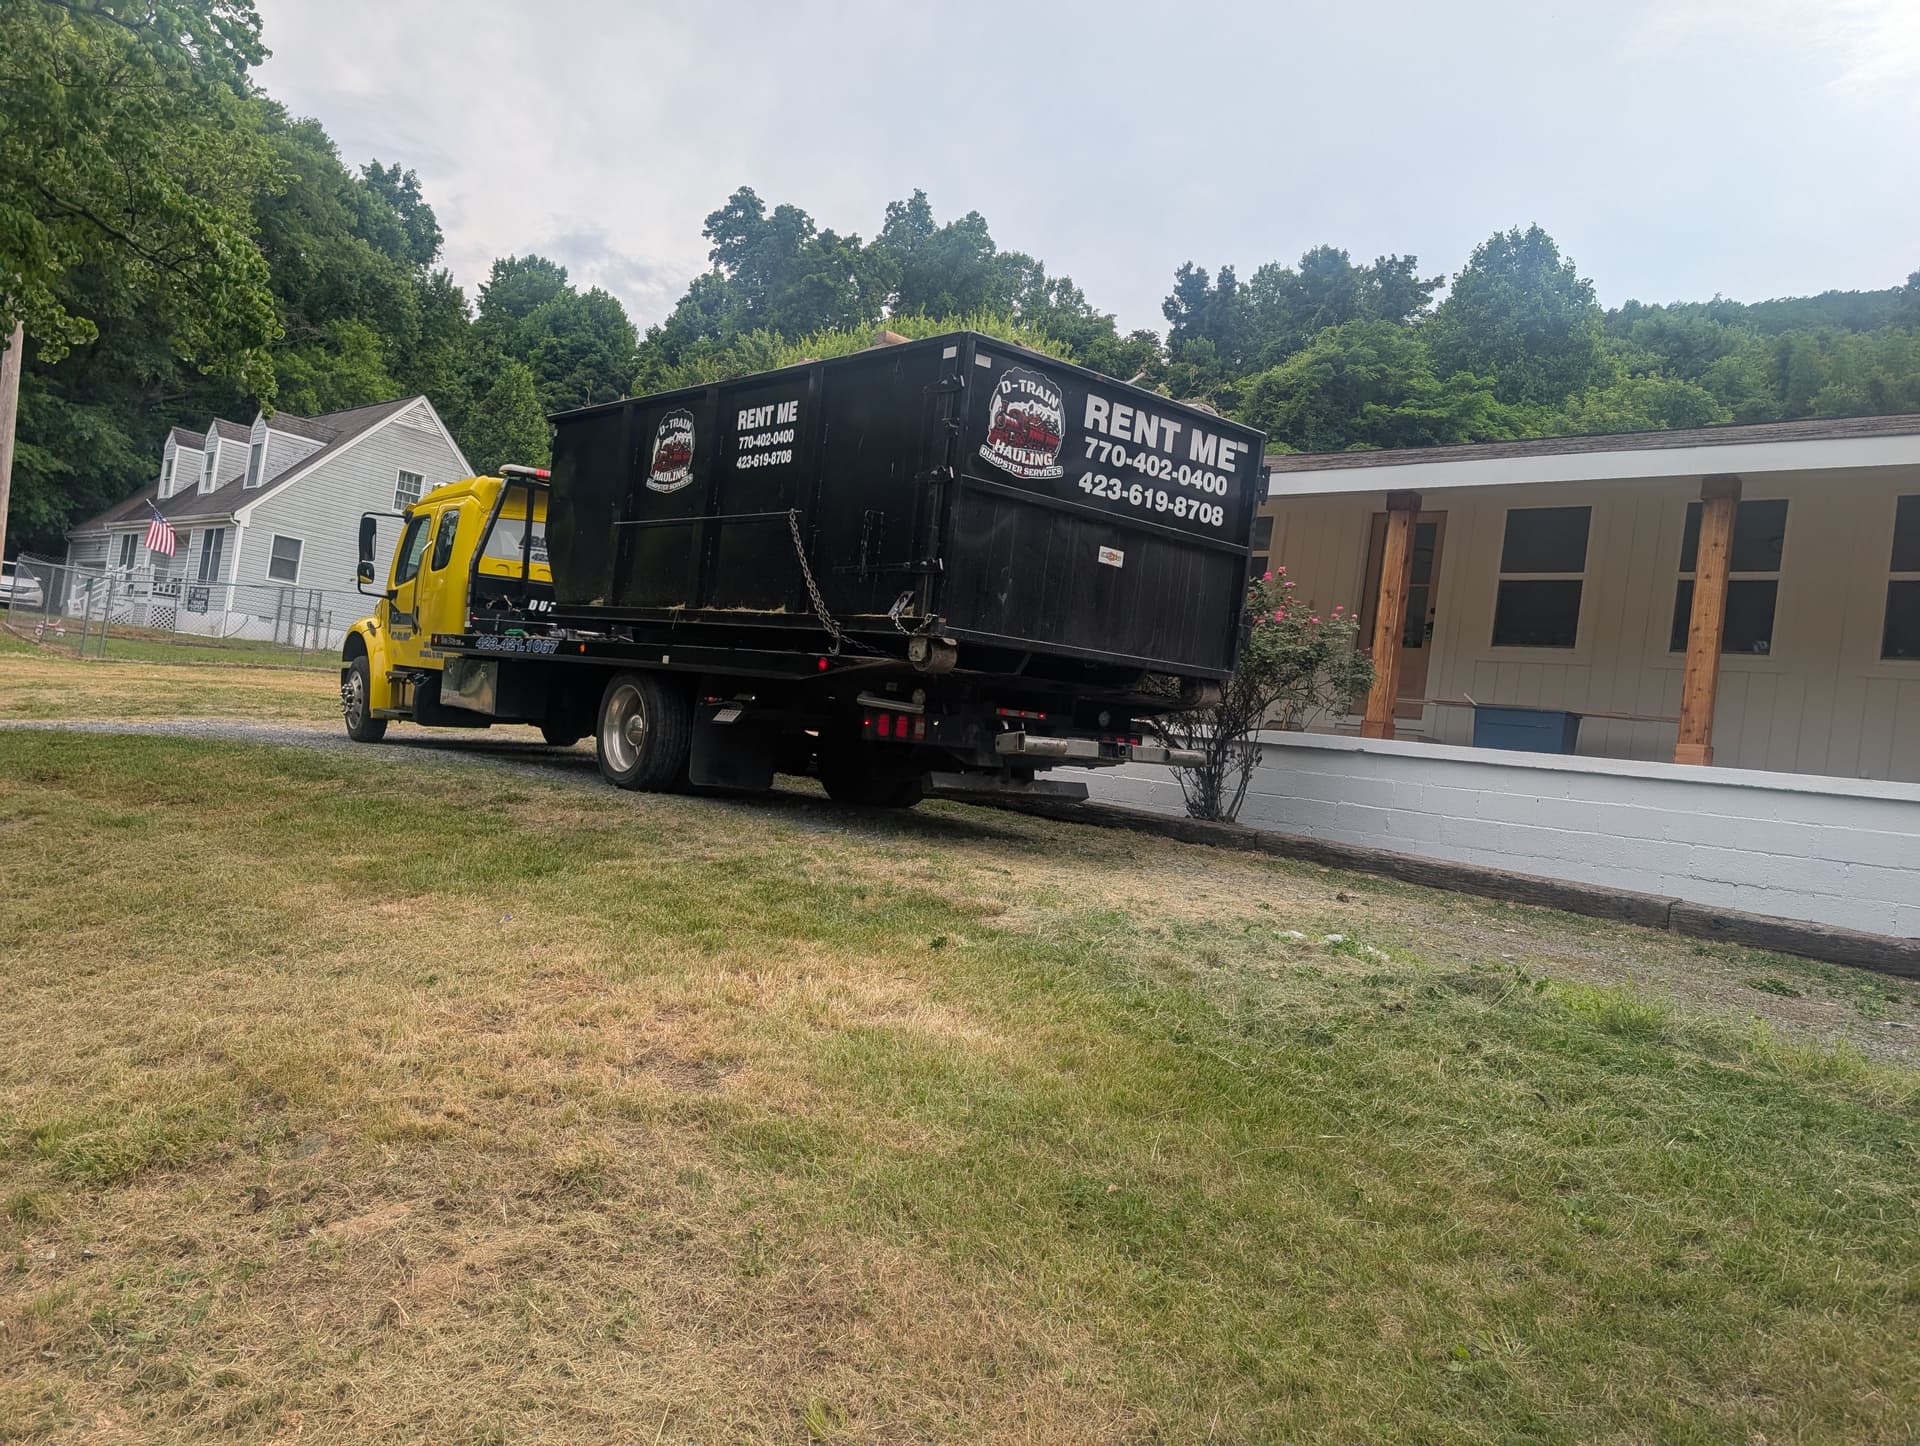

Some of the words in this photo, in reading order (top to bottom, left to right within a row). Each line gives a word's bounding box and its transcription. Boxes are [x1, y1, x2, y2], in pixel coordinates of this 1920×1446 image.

[1001, 379, 1059, 409] D-TRAIN
[660, 418, 692, 436] D-TRAIN
[737, 404, 774, 431] RENT
[776, 400, 799, 425] ME
[739, 428, 795, 450] 770-402-0400
[1083, 393, 1181, 454] RENT
[1189, 428, 1238, 473] ME
[736, 449, 792, 470] 423-619-8708
[980, 447, 1023, 475] DUMPSTER
[1023, 467, 1062, 477] SERVICES
[993, 439, 1053, 466] HAULING
[1084, 436, 1228, 497] 770-402-0400
[653, 467, 687, 482] HAULING
[1078, 471, 1224, 527] 423-619-8708
